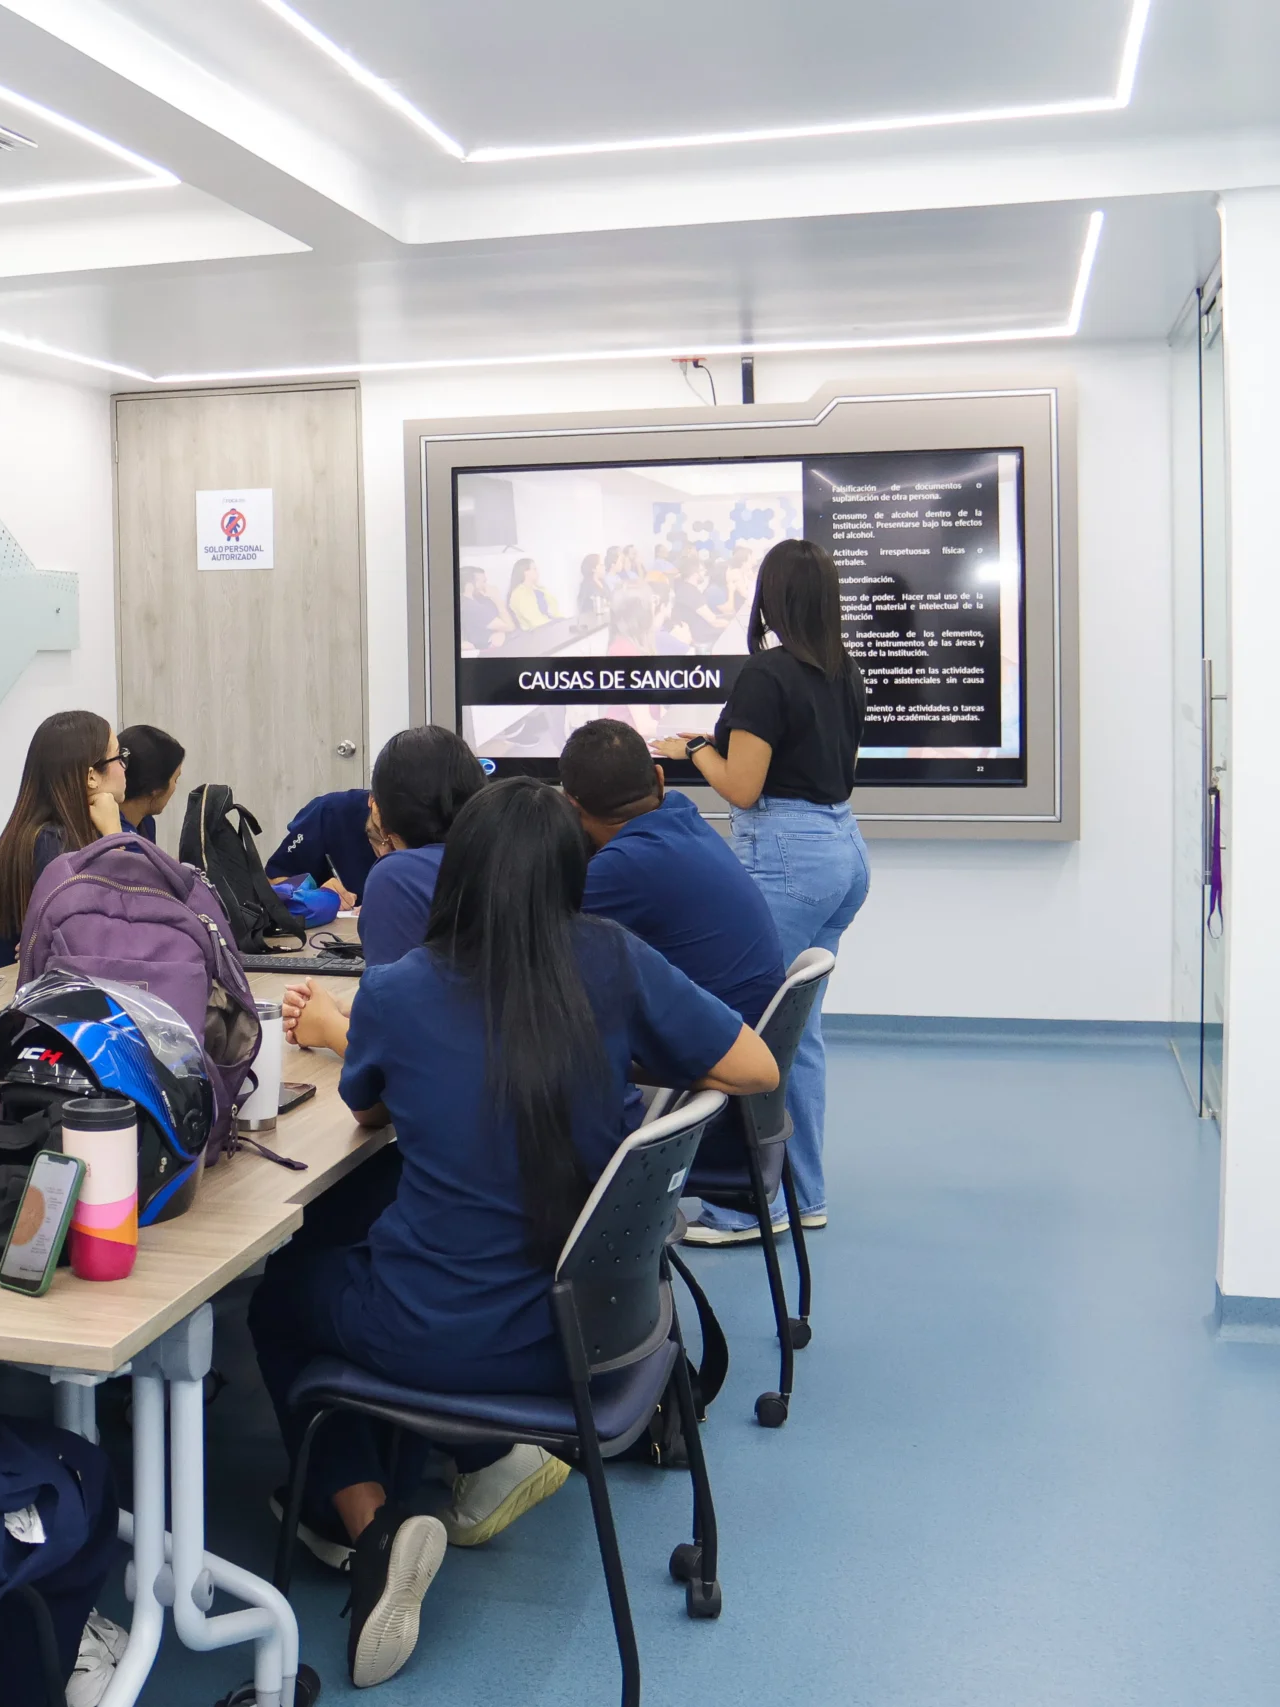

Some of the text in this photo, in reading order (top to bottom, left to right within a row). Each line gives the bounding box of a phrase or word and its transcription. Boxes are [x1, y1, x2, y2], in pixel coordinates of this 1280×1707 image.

[832, 484, 877, 492] Falsificación
[891, 483, 901, 491] de
[915, 482, 962, 491] documentos
[832, 493, 941, 503] suplantación de otra persona.
[832, 512, 867, 521] Consumo
[874, 511, 884, 519] de
[891, 511, 919, 519] alcohol
[925, 510, 951, 518] dentro
[975, 509, 982, 517] la
[922, 520, 939, 529] bajo
[941, 519, 952, 527] los
[955, 519, 982, 527] efectos
[833, 531, 875, 539] del alcohol.
[224, 545, 264, 553] PERSONAL
[833, 548, 868, 557] Actitudes
[880, 547, 930, 557] irrespetuosas
[211, 553, 257, 561] AUTORIZADO
[833, 558, 866, 566] verbales.
[840, 593, 857, 602] buso
[860, 593, 870, 601] de
[872, 593, 896, 603] poder.
[902, 593, 924, 601] Hacer
[960, 592, 970, 600] de
[876, 602, 907, 610] material
[919, 602, 959, 610] intelectual
[962, 602, 972, 610] de
[906, 630, 916, 638] de
[924, 630, 935, 638] los
[942, 630, 984, 639] elementos,
[876, 639, 925, 647] instrumentos
[928, 639, 938, 647] de
[941, 638, 952, 646] las
[955, 638, 976, 646] áreas
[979, 640, 984, 648] y
[868, 649, 878, 657] de
[888, 649, 929, 657] Institución.
[868, 667, 913, 676] puntualidad
[518, 665, 721, 690] CAUSAS DE SANCIÓN
[894, 676, 941, 684] asistenciales
[946, 676, 957, 684] sin
[883, 714, 896, 722] y/o
[897, 713, 940, 722] académicas
[941, 714, 980, 722] asignadas.
